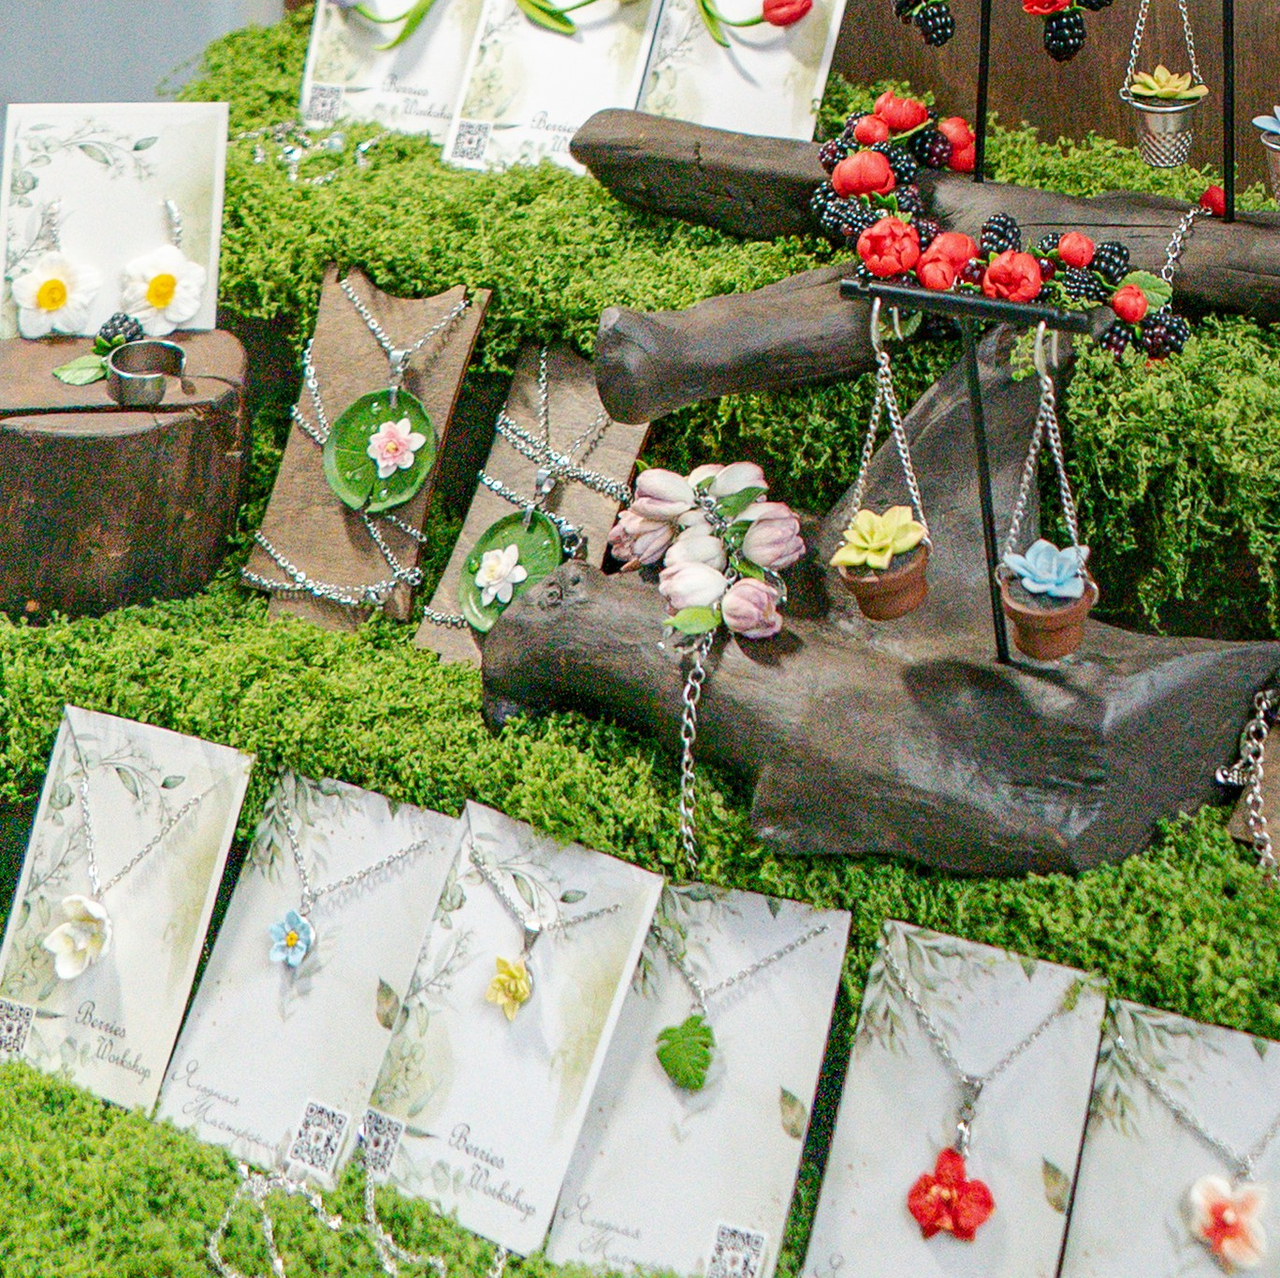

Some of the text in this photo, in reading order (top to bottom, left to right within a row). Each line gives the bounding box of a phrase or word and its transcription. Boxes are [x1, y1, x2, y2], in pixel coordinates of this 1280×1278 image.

[403, 97, 453, 120] Worksho
[75, 1000, 126, 1038] Berries
[97, 1036, 151, 1084] Workshop
[448, 1122, 505, 1170] Berries
[469, 1162, 536, 1222] Workshop
